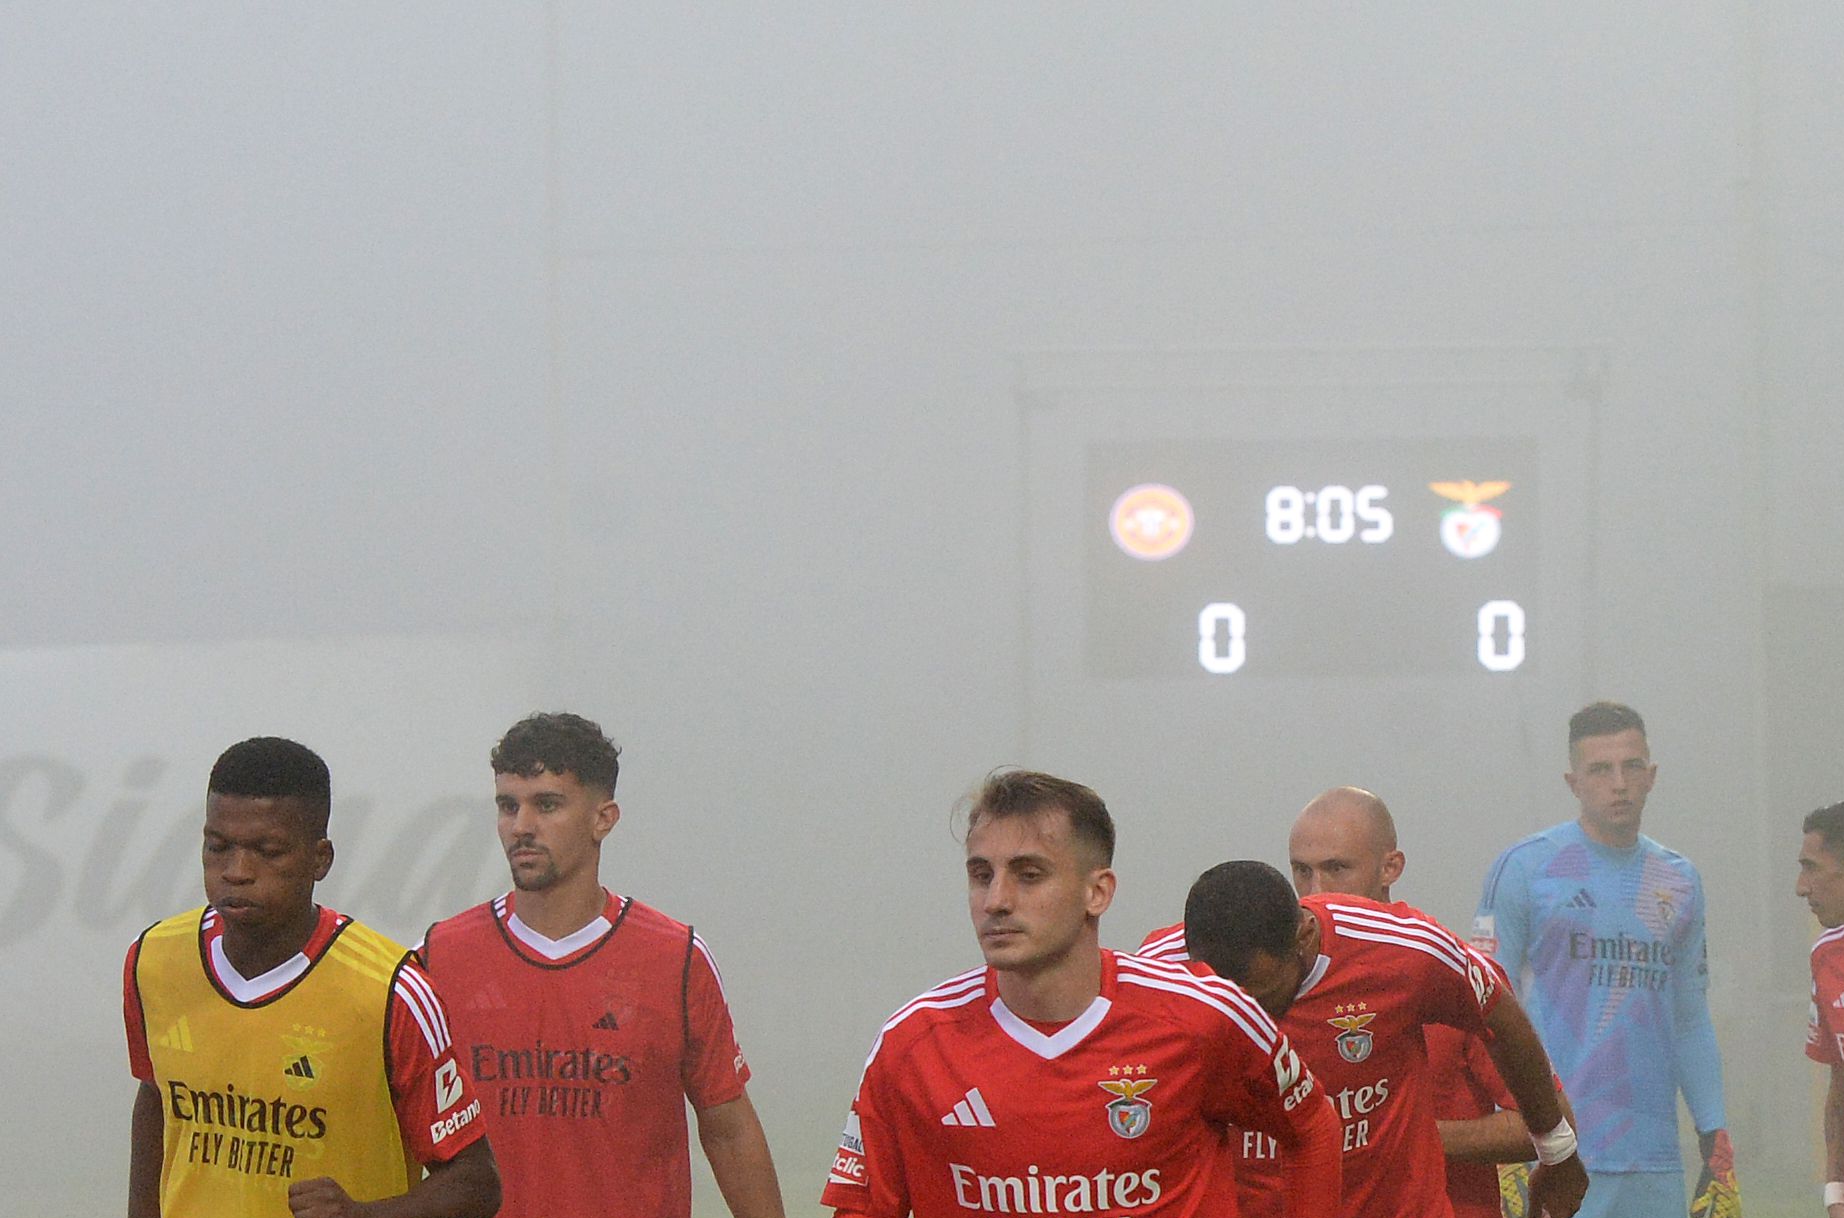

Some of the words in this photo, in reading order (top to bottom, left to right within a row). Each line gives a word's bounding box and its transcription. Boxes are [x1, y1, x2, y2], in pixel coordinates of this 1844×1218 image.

[1264, 484, 1394, 545] 8:05
[1198, 602, 1246, 673] 0
[1476, 600, 1526, 671] 0
[471, 1039, 633, 1086] Emirates
[168, 1080, 328, 1140] Emirates
[430, 1098, 482, 1145] Betano
[188, 1132, 224, 1166] FLY
[1242, 1131, 1277, 1160] FLY
[949, 1162, 1162, 1214] Emirates
